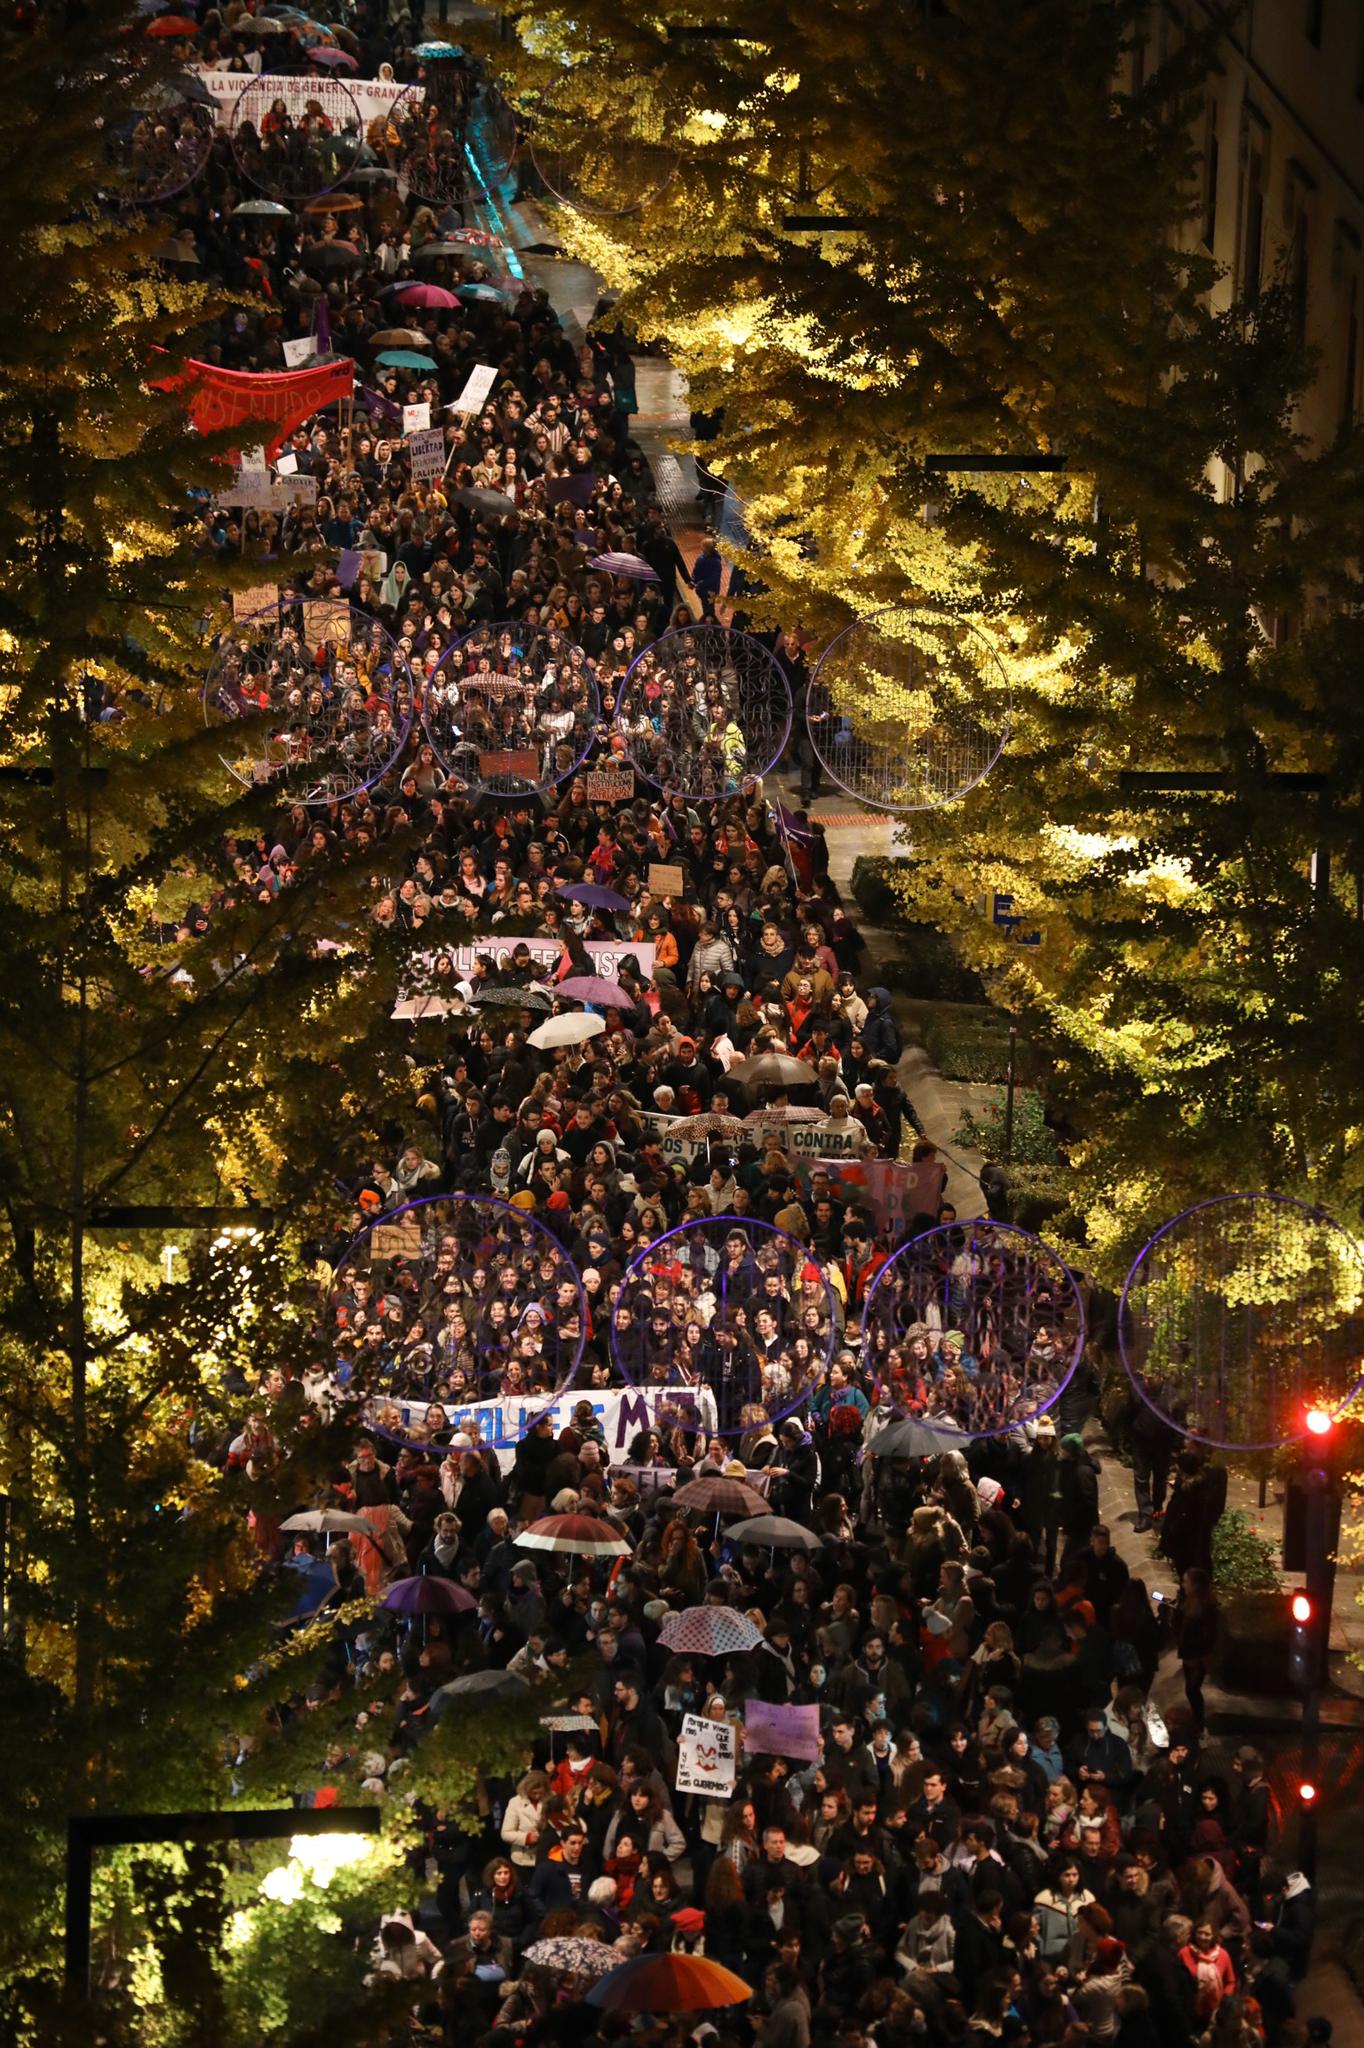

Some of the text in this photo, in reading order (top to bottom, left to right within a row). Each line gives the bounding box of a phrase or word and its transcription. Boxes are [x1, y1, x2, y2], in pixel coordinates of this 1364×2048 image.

[211, 80, 225, 92] LA
[228, 80, 284, 94] VIOLENCIA
[287, 81, 301, 93] DE
[349, 83, 363, 95] DE
[411, 442, 443, 456] LIBERTAD
[413, 467, 445, 479] CALIDAD
[589, 771, 632, 781] VIOLENCIA
[428, 944, 512, 971] OLITIC
[530, 949, 637, 978] FEIST
[793, 1131, 853, 1150] CONTRA
[716, 1733, 729, 1742] QUE
[693, 1778, 729, 1792] QUEREMOS
